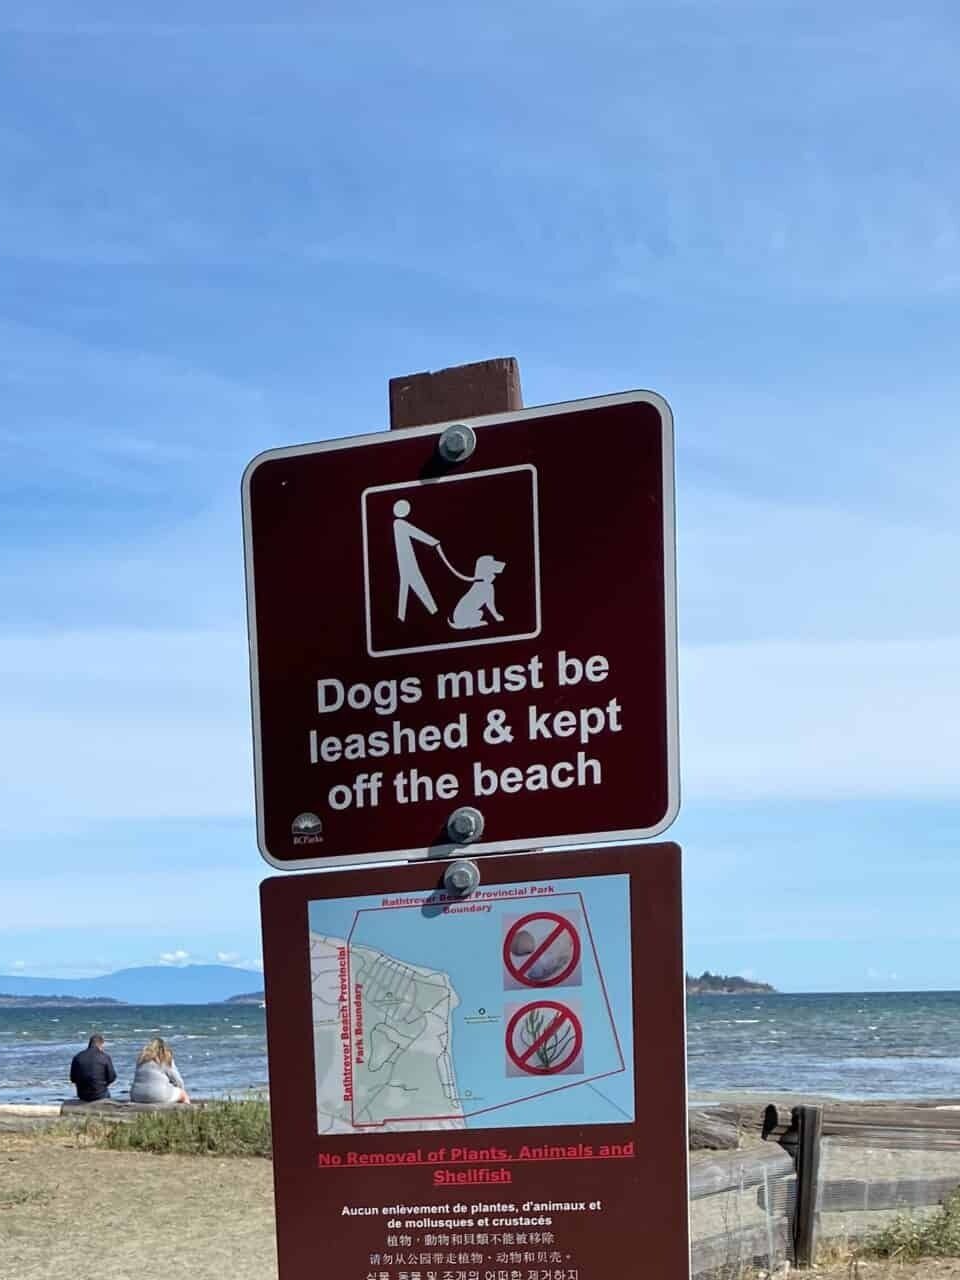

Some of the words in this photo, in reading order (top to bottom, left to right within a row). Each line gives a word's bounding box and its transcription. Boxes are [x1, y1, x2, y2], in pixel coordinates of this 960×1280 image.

[317, 677, 422, 715] Dogs
[437, 655, 544, 699] must
[557, 650, 609, 686] be
[309, 713, 468, 764] leashed
[483, 709, 514, 744] &
[528, 697, 622, 744] kept
[328, 772, 383, 810] off
[393, 769, 459, 804] the
[473, 752, 602, 797] beach
[475, 887, 527, 899] Provincial
[530, 886, 555, 895] Park
[443, 902, 492, 914] Boundary
[338, 946, 348, 1002] Provincial
[341, 1004, 350, 1040] Beach
[354, 983, 363, 1036] Boundary
[356, 1038, 364, 1064] Park
[343, 1043, 353, 1102] Rathtrevor
[319, 1153, 342, 1165] No
[347, 1150, 422, 1165] Removal
[427, 1148, 447, 1162] of
[519, 1144, 592, 1160] Animals
[599, 1142, 634, 1157] and
[434, 1168, 512, 1184] Shellfish
[341, 1206, 379, 1216] Aucun
[382, 1204, 449, 1215] enlèvement
[452, 1203, 468, 1214] de
[471, 1201, 519, 1215] plantes,
[522, 1200, 586, 1212] d'animaux
[589, 1200, 602, 1210] et
[387, 1218, 402, 1229] de
[405, 1218, 474, 1229] mollusques
[477, 1217, 489, 1227] et
[492, 1215, 552, 1227] crustacés
[527, 1269, 578, 1280] 제거하지
